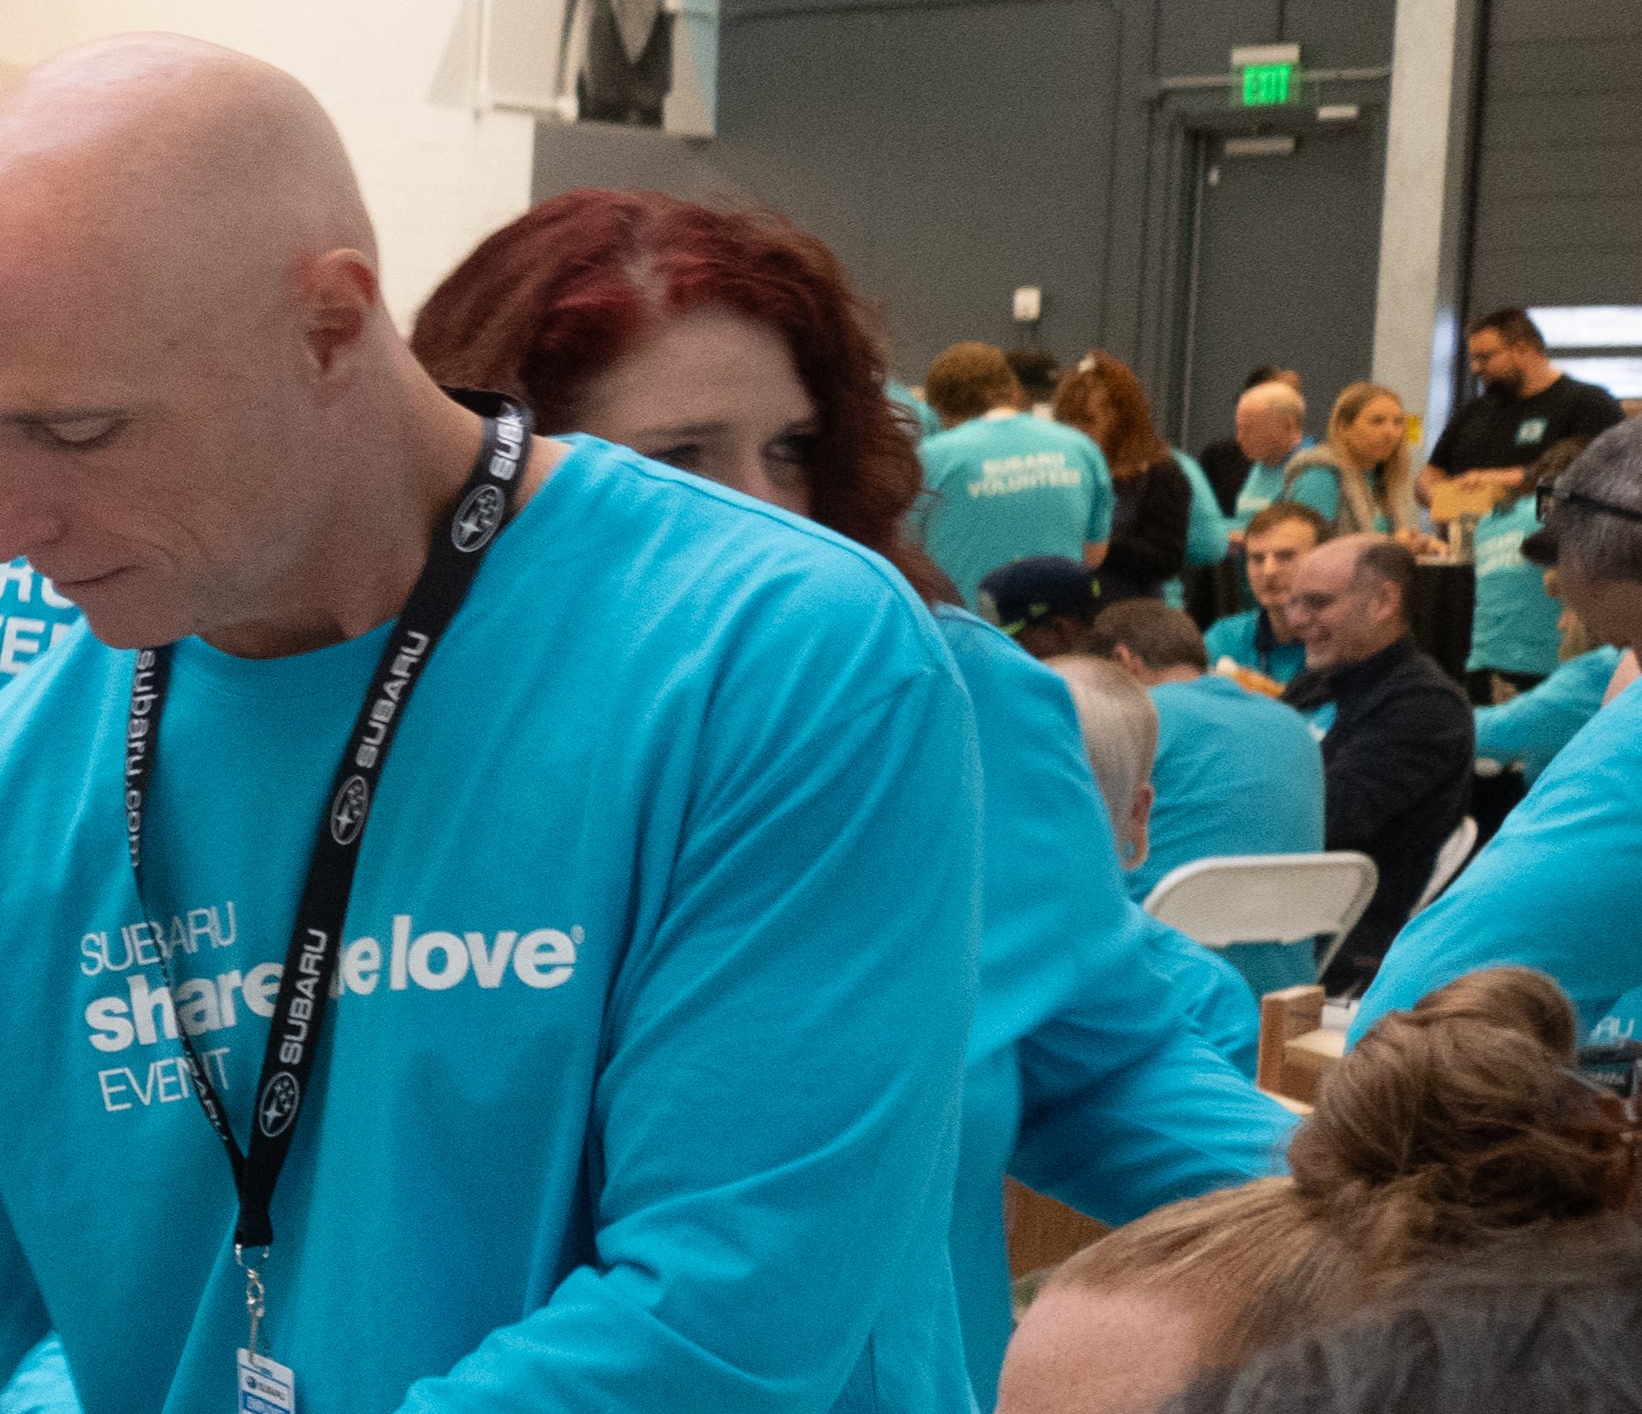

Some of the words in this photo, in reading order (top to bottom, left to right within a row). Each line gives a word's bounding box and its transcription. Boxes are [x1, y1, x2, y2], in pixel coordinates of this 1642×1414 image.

[355, 630, 430, 769] SUBARU
[80, 901, 238, 978] SUBARU
[279, 928, 328, 1065] SUBARU
[84, 962, 283, 1053] share
